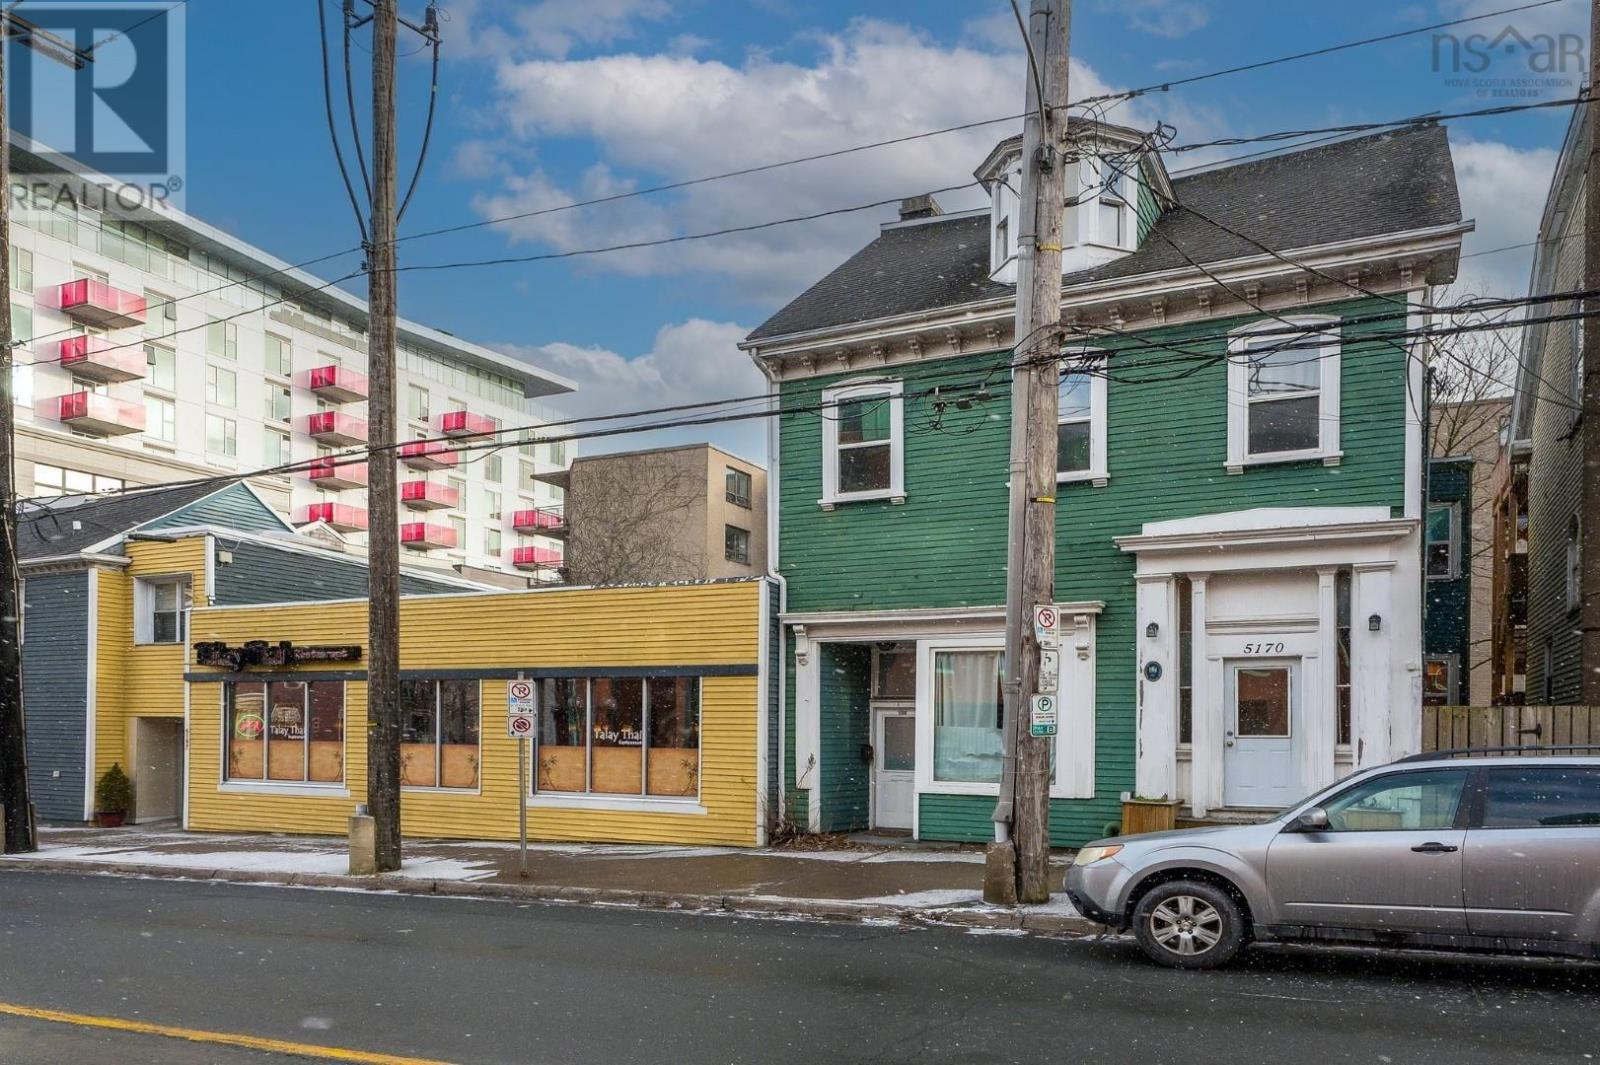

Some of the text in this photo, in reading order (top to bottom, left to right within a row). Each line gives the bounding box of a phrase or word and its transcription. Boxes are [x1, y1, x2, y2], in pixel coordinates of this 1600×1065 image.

[1243, 642, 1285, 654] 5170
[270, 724, 289, 737] Talay
[594, 726, 619, 743] Talay
